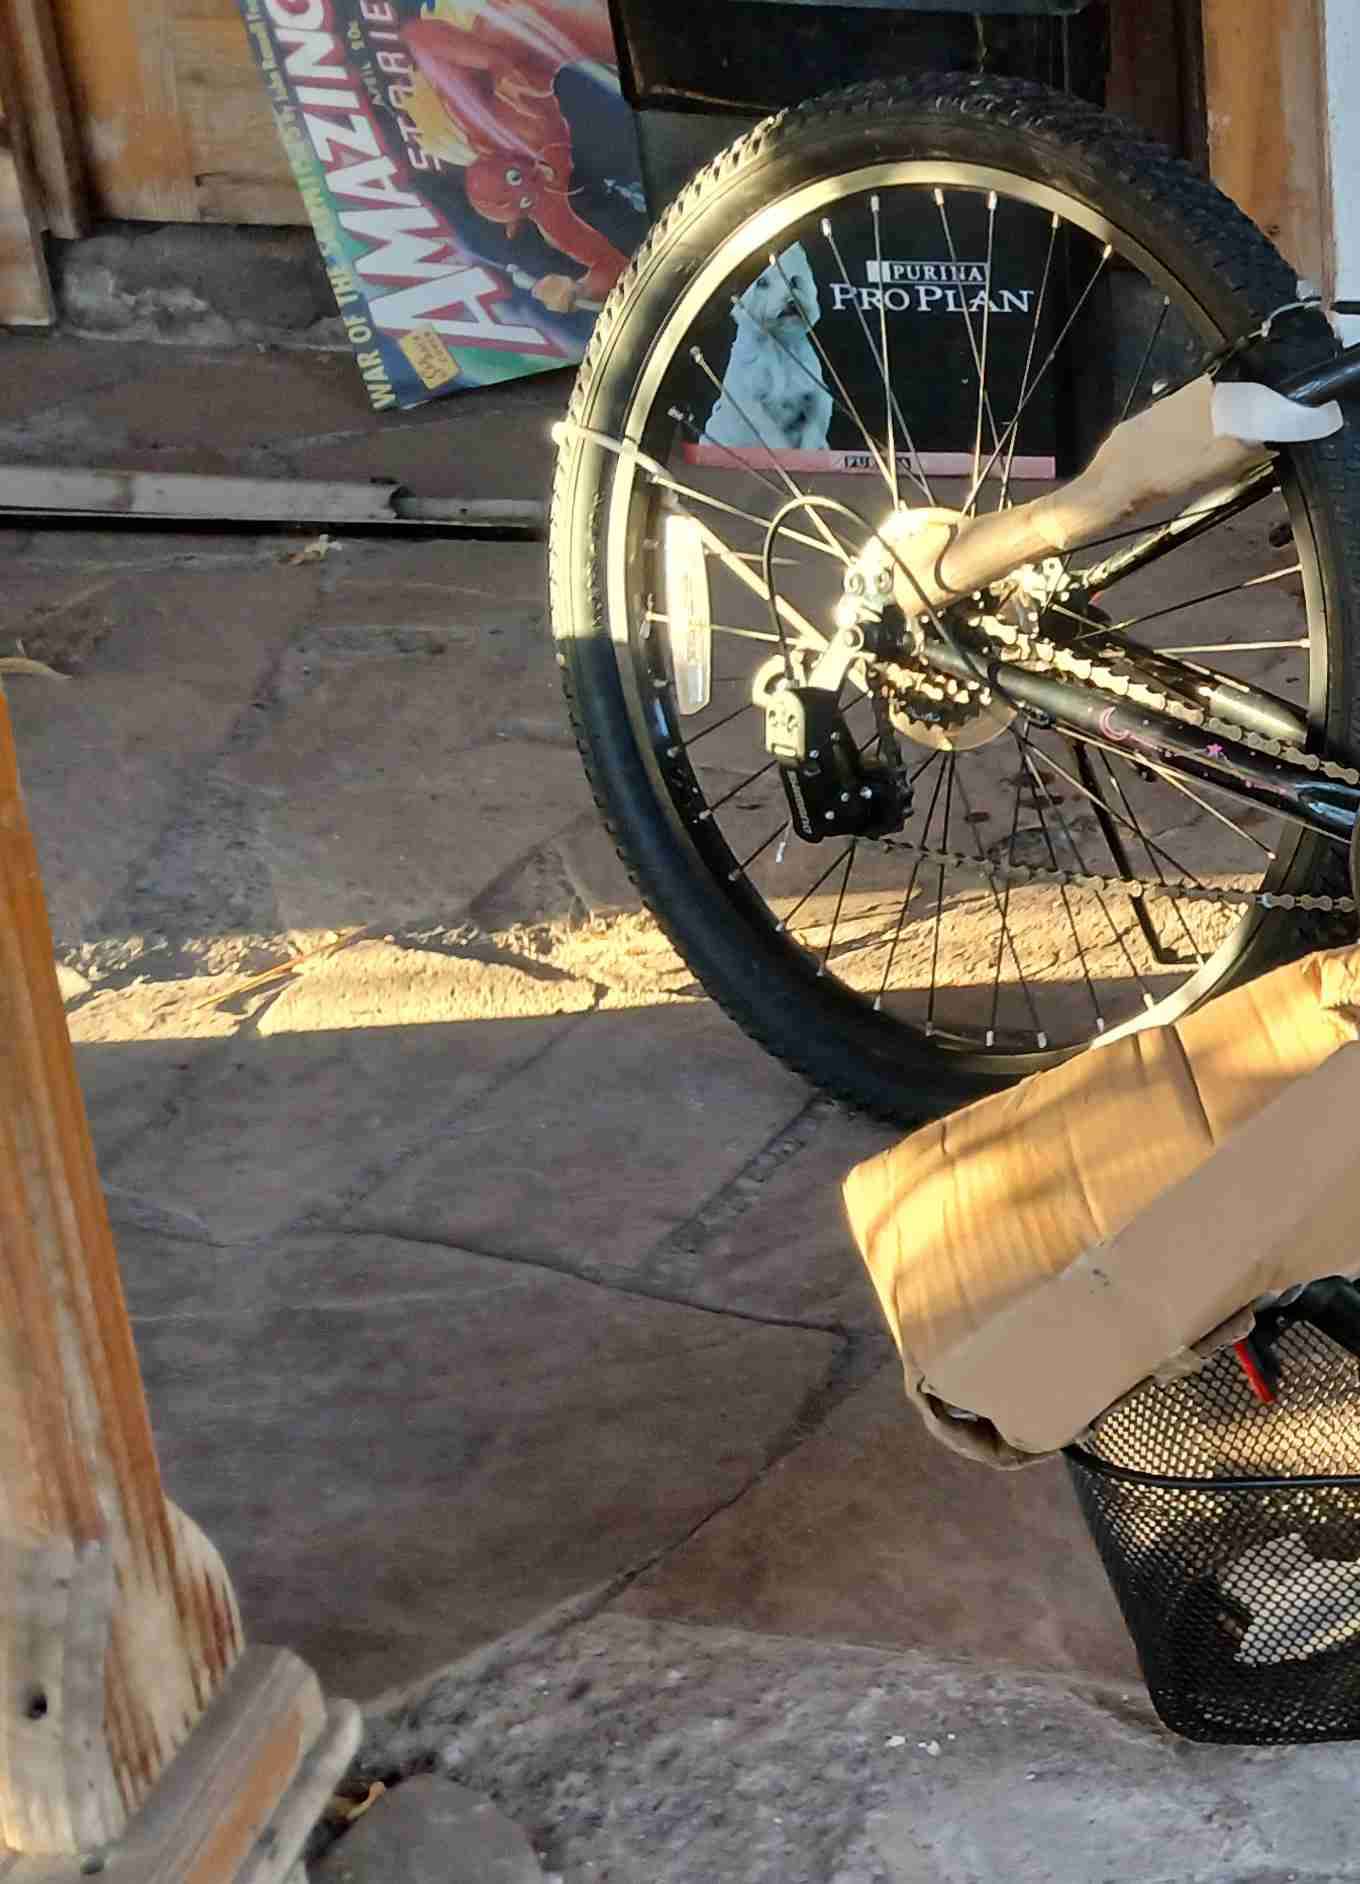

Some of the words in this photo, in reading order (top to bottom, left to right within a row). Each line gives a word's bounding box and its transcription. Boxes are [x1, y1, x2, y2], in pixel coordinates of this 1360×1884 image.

[893, 264, 984, 282] PURINA
[830, 283, 910, 312] PRO
[916, 286, 1035, 313] PLAN
[342, 314, 372, 344] OF
[356, 350, 396, 409] WAR
